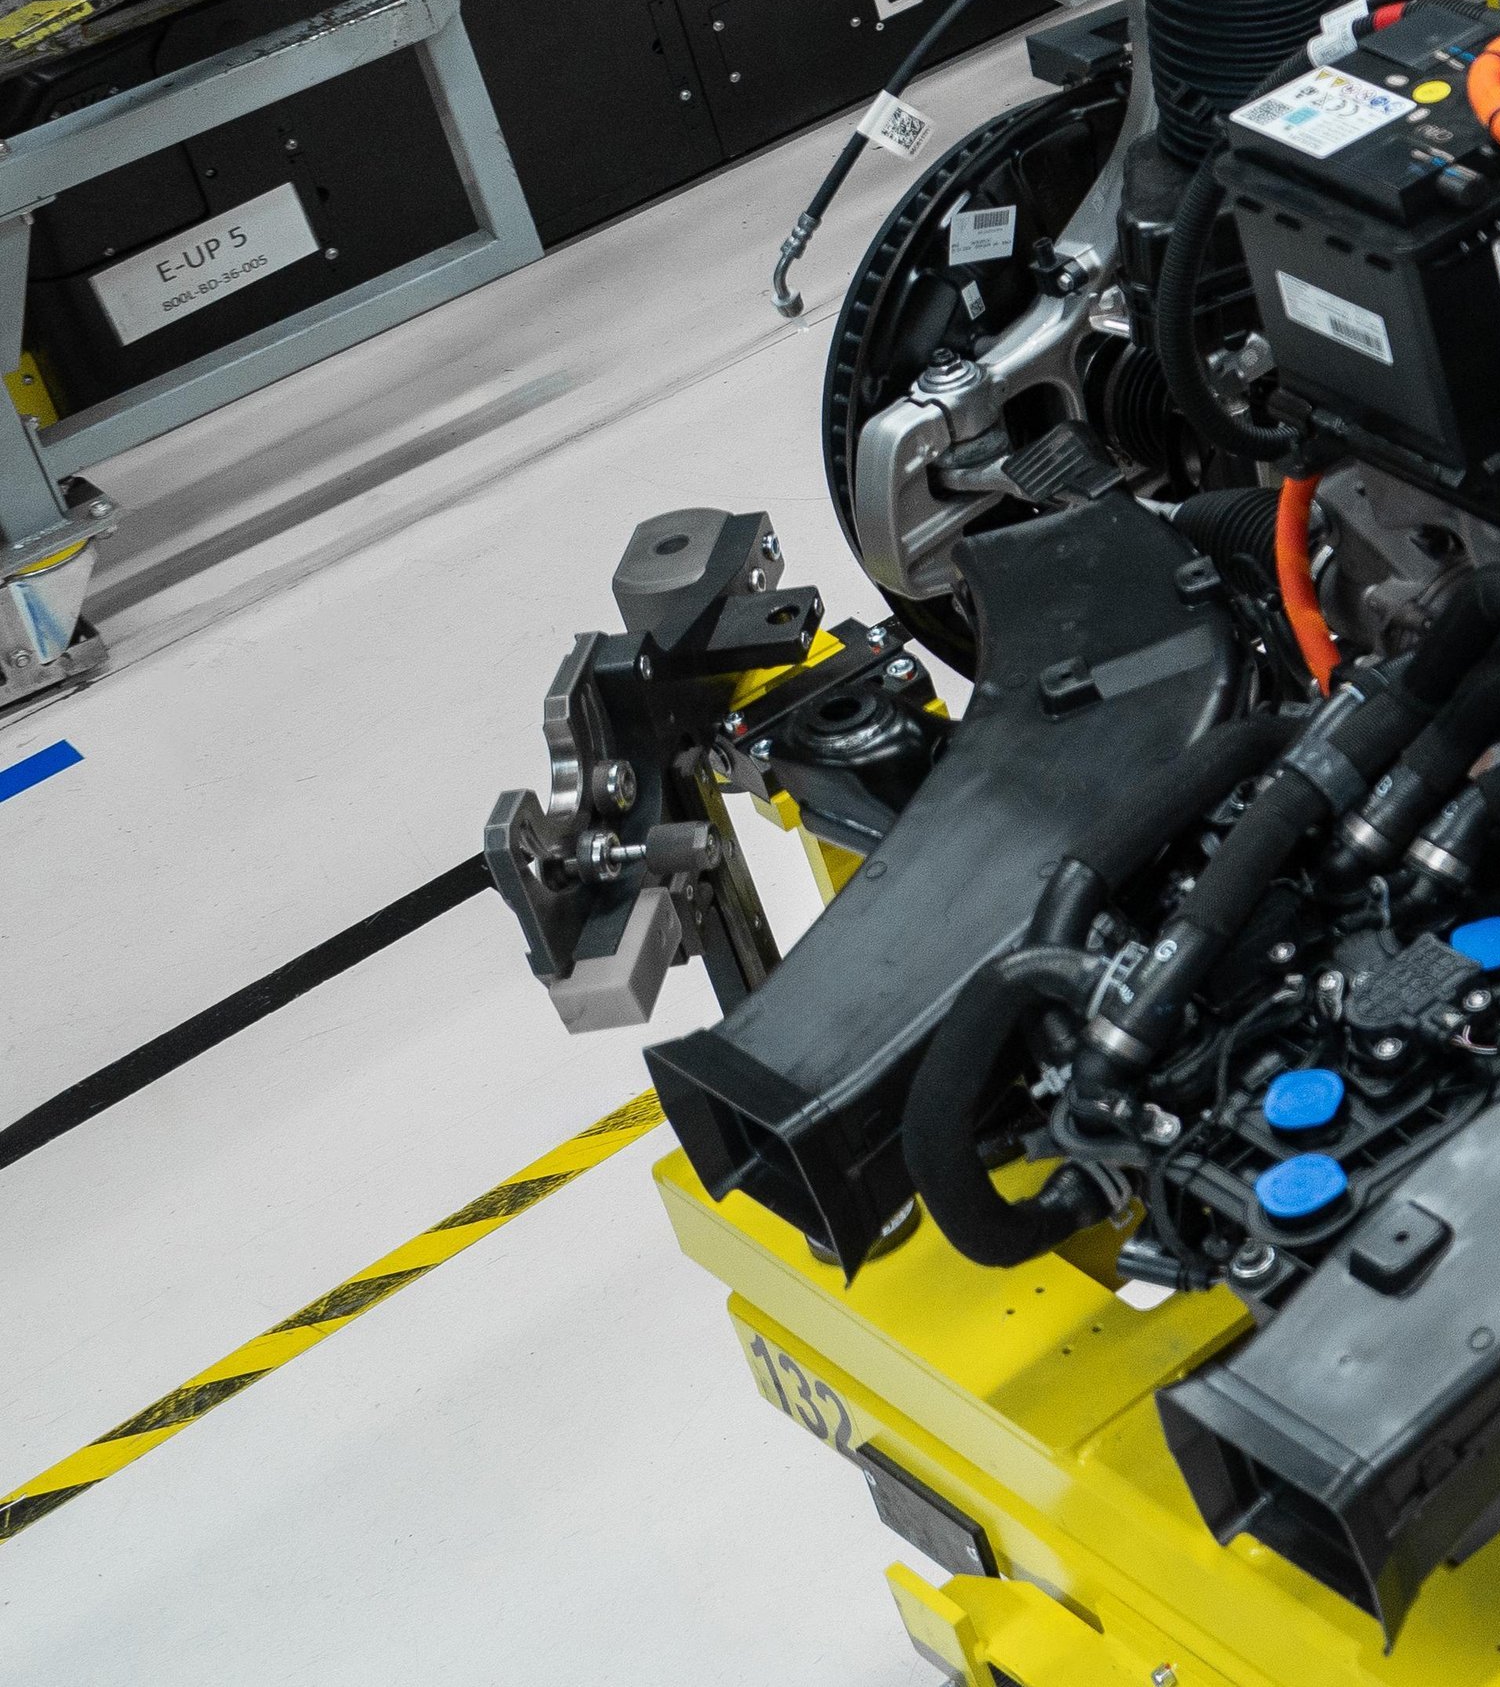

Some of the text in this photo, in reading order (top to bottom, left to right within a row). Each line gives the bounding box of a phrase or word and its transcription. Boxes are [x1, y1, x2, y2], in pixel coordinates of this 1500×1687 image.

[155, 225, 248, 283] E-UP 5
[750, 1334, 862, 1462] 132
